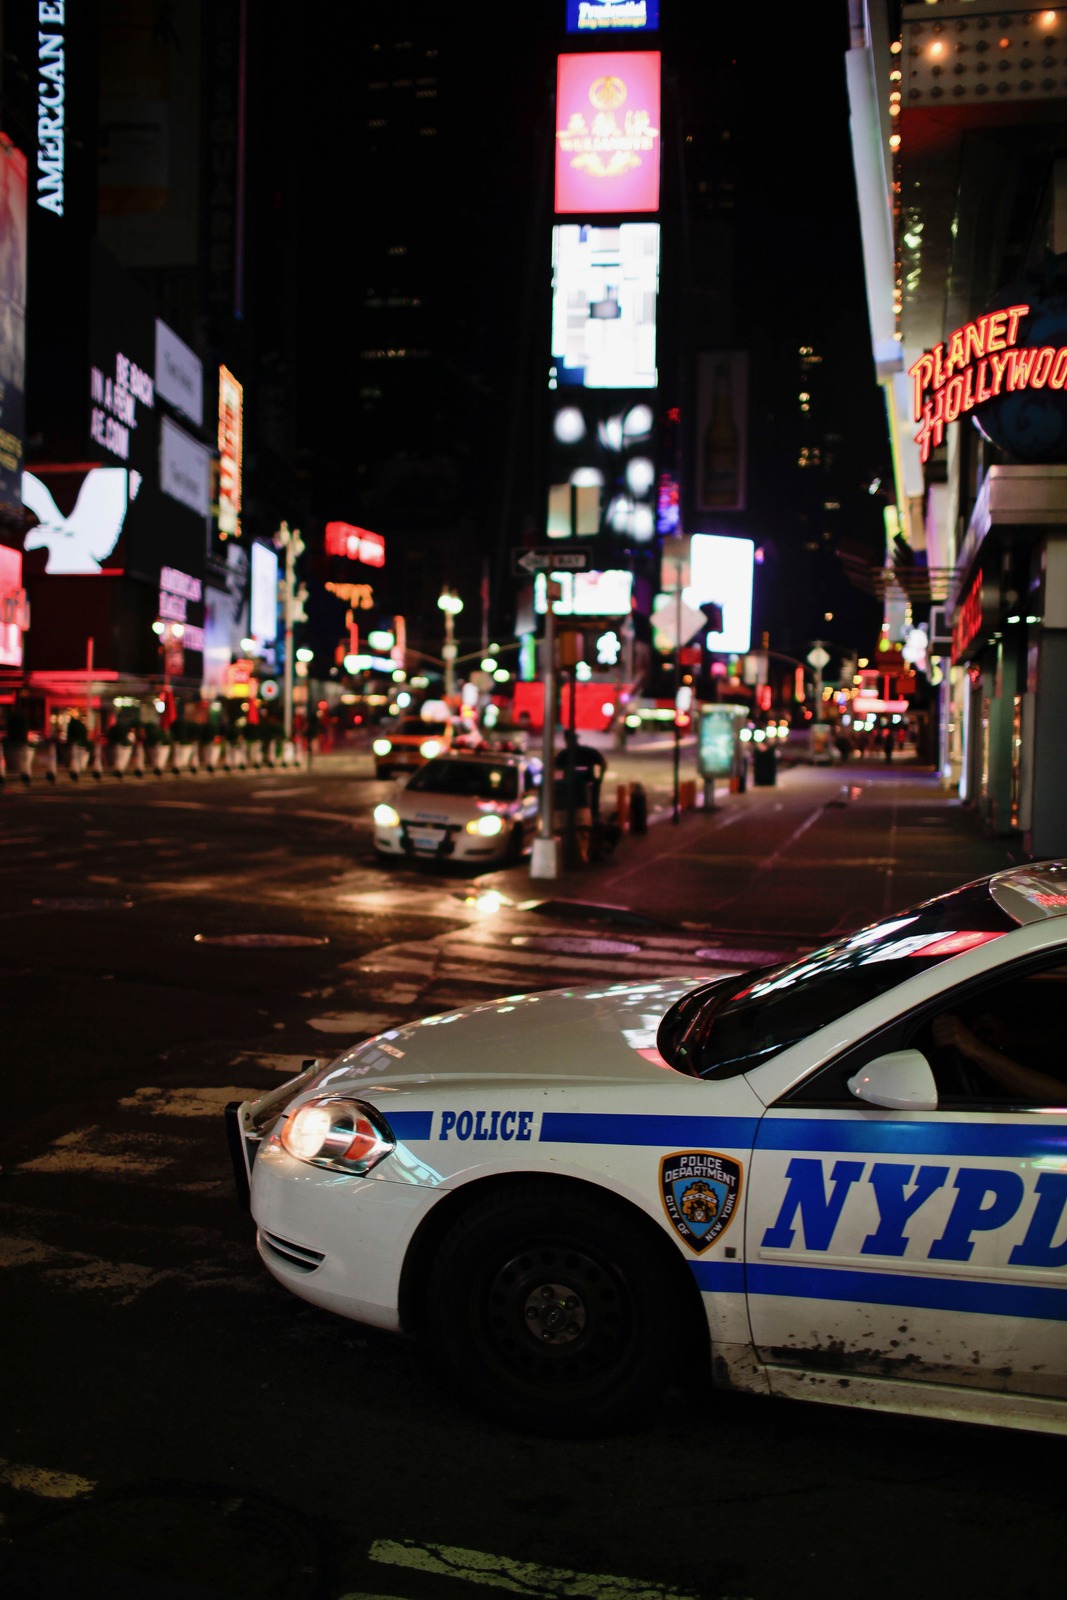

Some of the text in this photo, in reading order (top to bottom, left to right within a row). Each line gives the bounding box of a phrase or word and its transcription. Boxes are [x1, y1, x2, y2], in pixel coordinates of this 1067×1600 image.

[37, 0, 66, 217] AMERICAN E
[909, 304, 1030, 422] PLANET
[913, 345, 1067, 464] HOLLYWOO
[439, 1110, 534, 1141] POLICE
[665, 1165, 737, 1187] DEPARTMENT
[680, 1156, 722, 1169] POLICE
[665, 1192, 737, 1242] CITY OF NEW YORK
